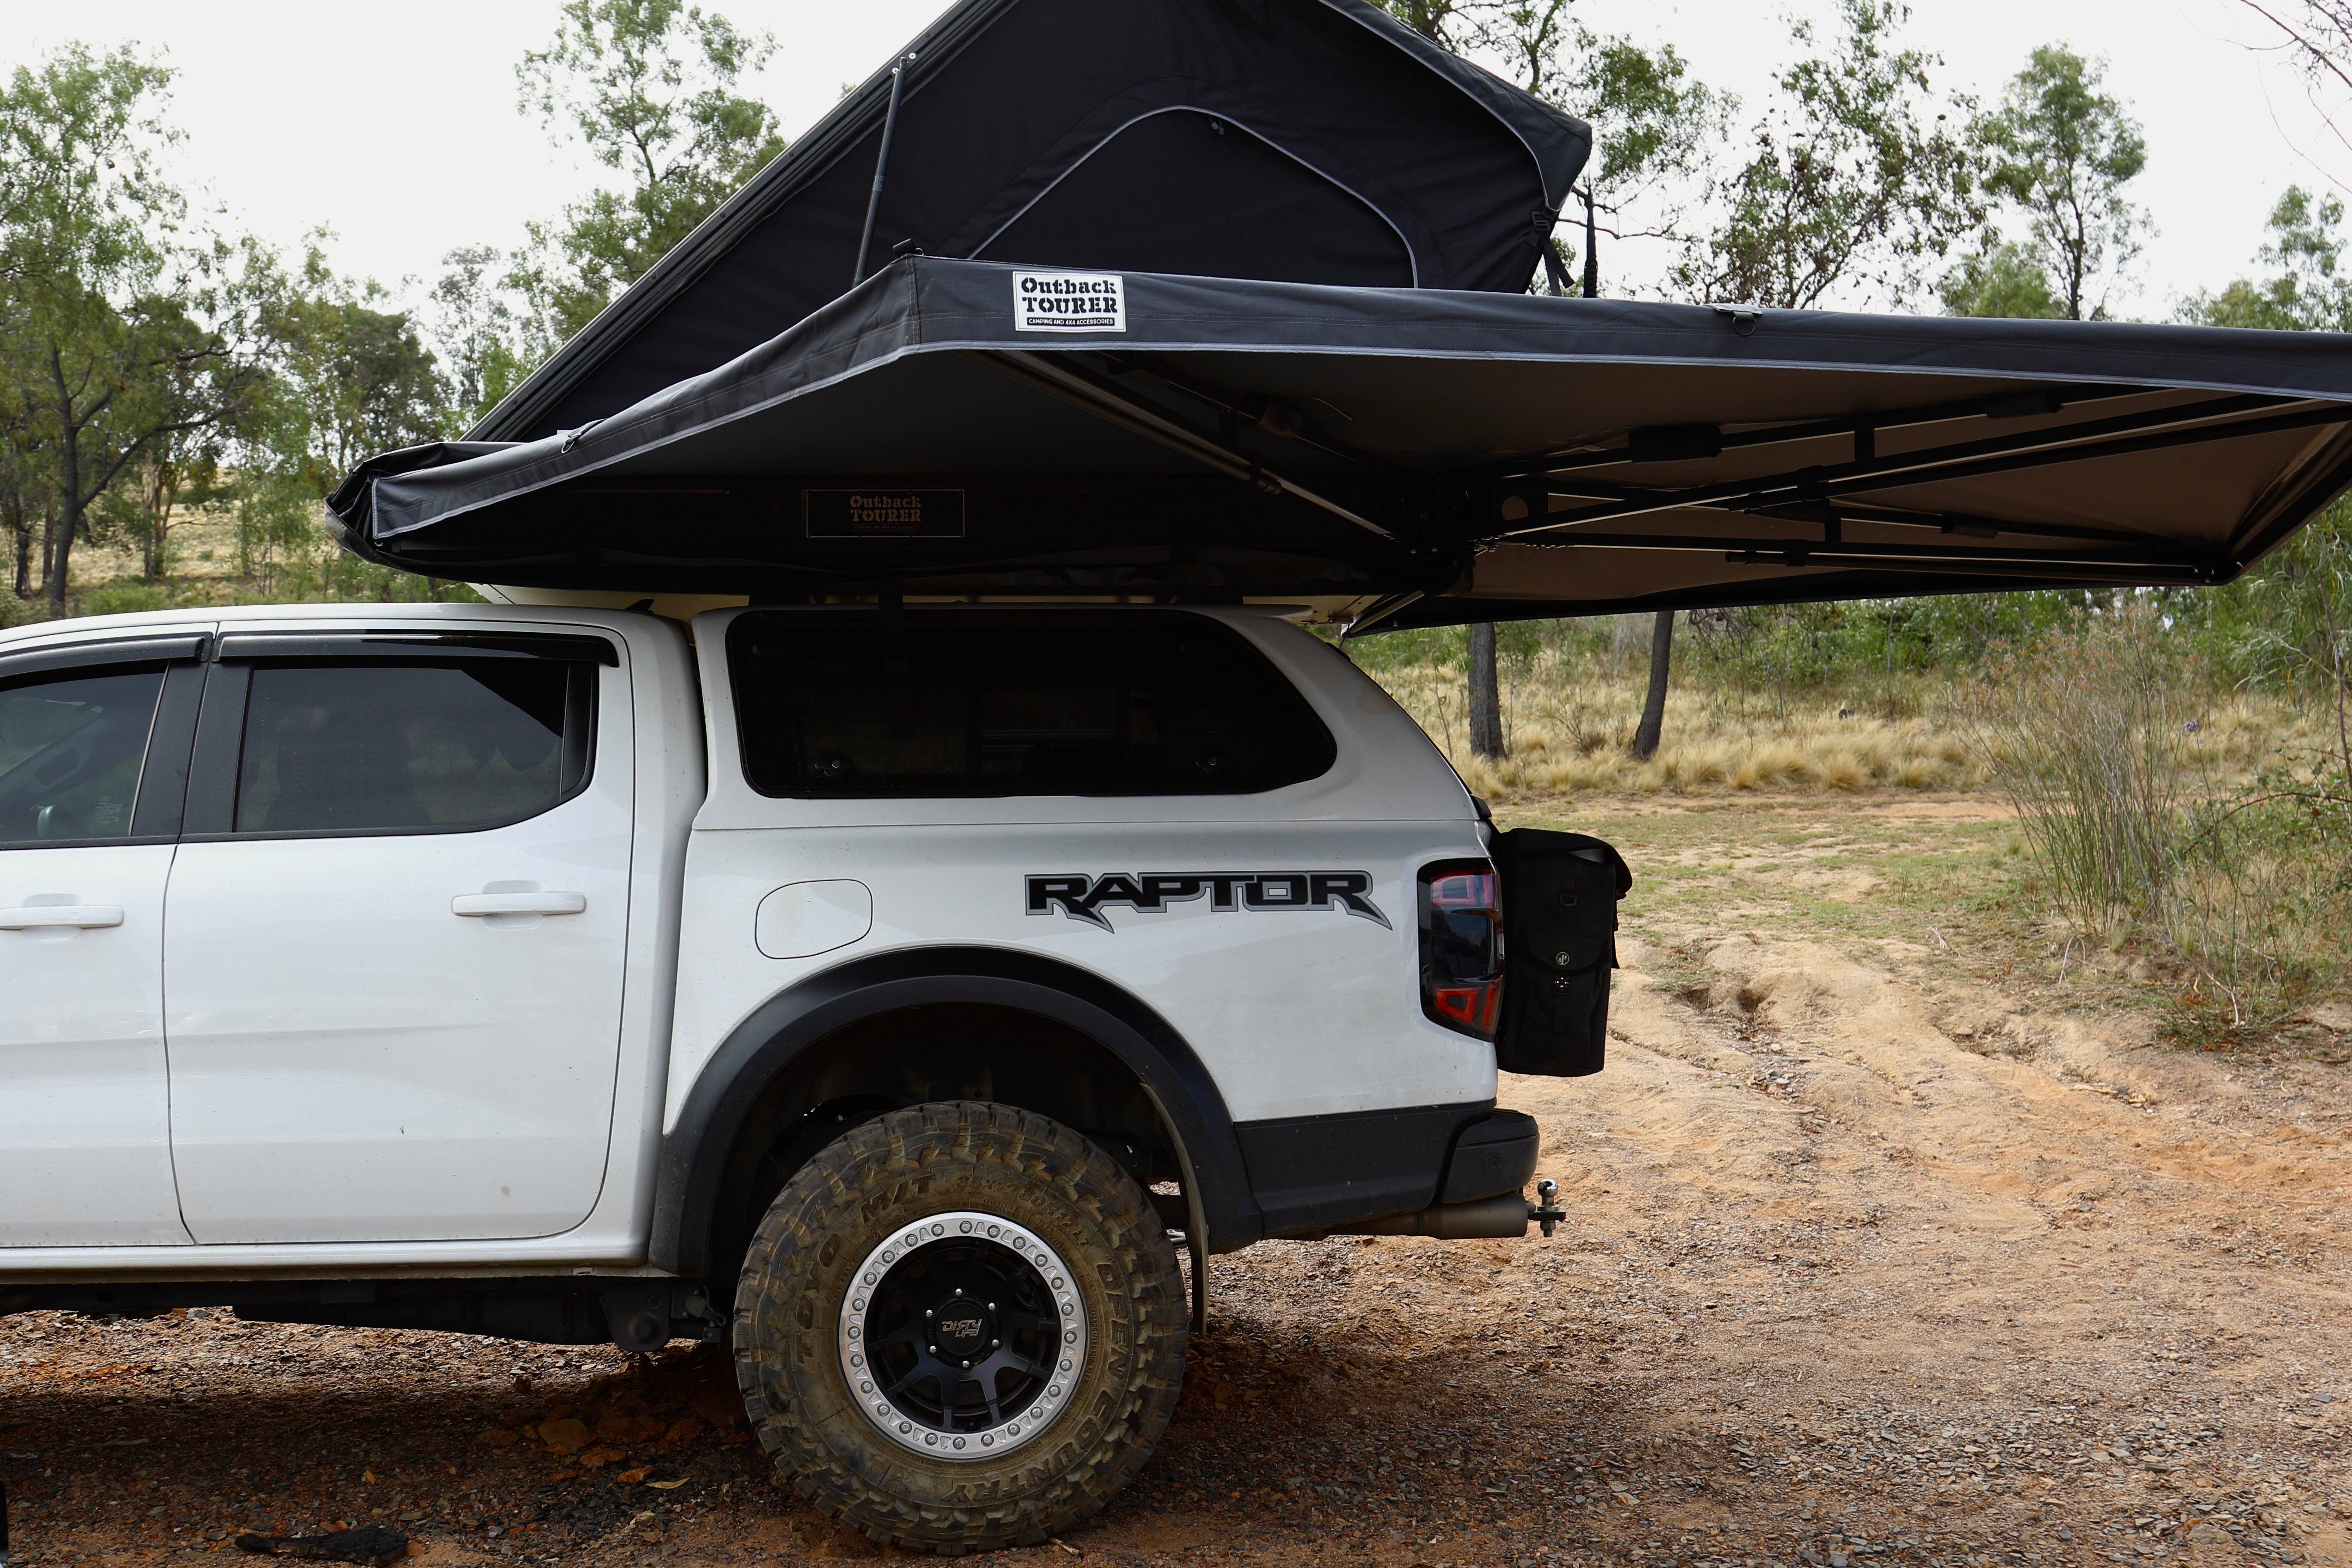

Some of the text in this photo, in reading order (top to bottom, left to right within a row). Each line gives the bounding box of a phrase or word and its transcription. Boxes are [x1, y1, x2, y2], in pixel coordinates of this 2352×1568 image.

[1021, 277, 1117, 294] Outback
[1022, 297, 1118, 314] TOURER
[850, 495, 921, 508] Outback
[850, 509, 921, 522] TOURER
[1024, 870, 1393, 934] RAPTOR
[860, 1173, 935, 1224] M/T
[796, 1234, 839, 1364] TOYO
[942, 1319, 982, 1332] DIRTY
[1096, 1263, 1128, 1378] OPEN
[955, 1329, 979, 1338] LIFE
[942, 1390, 1115, 1502] COUNTRY
